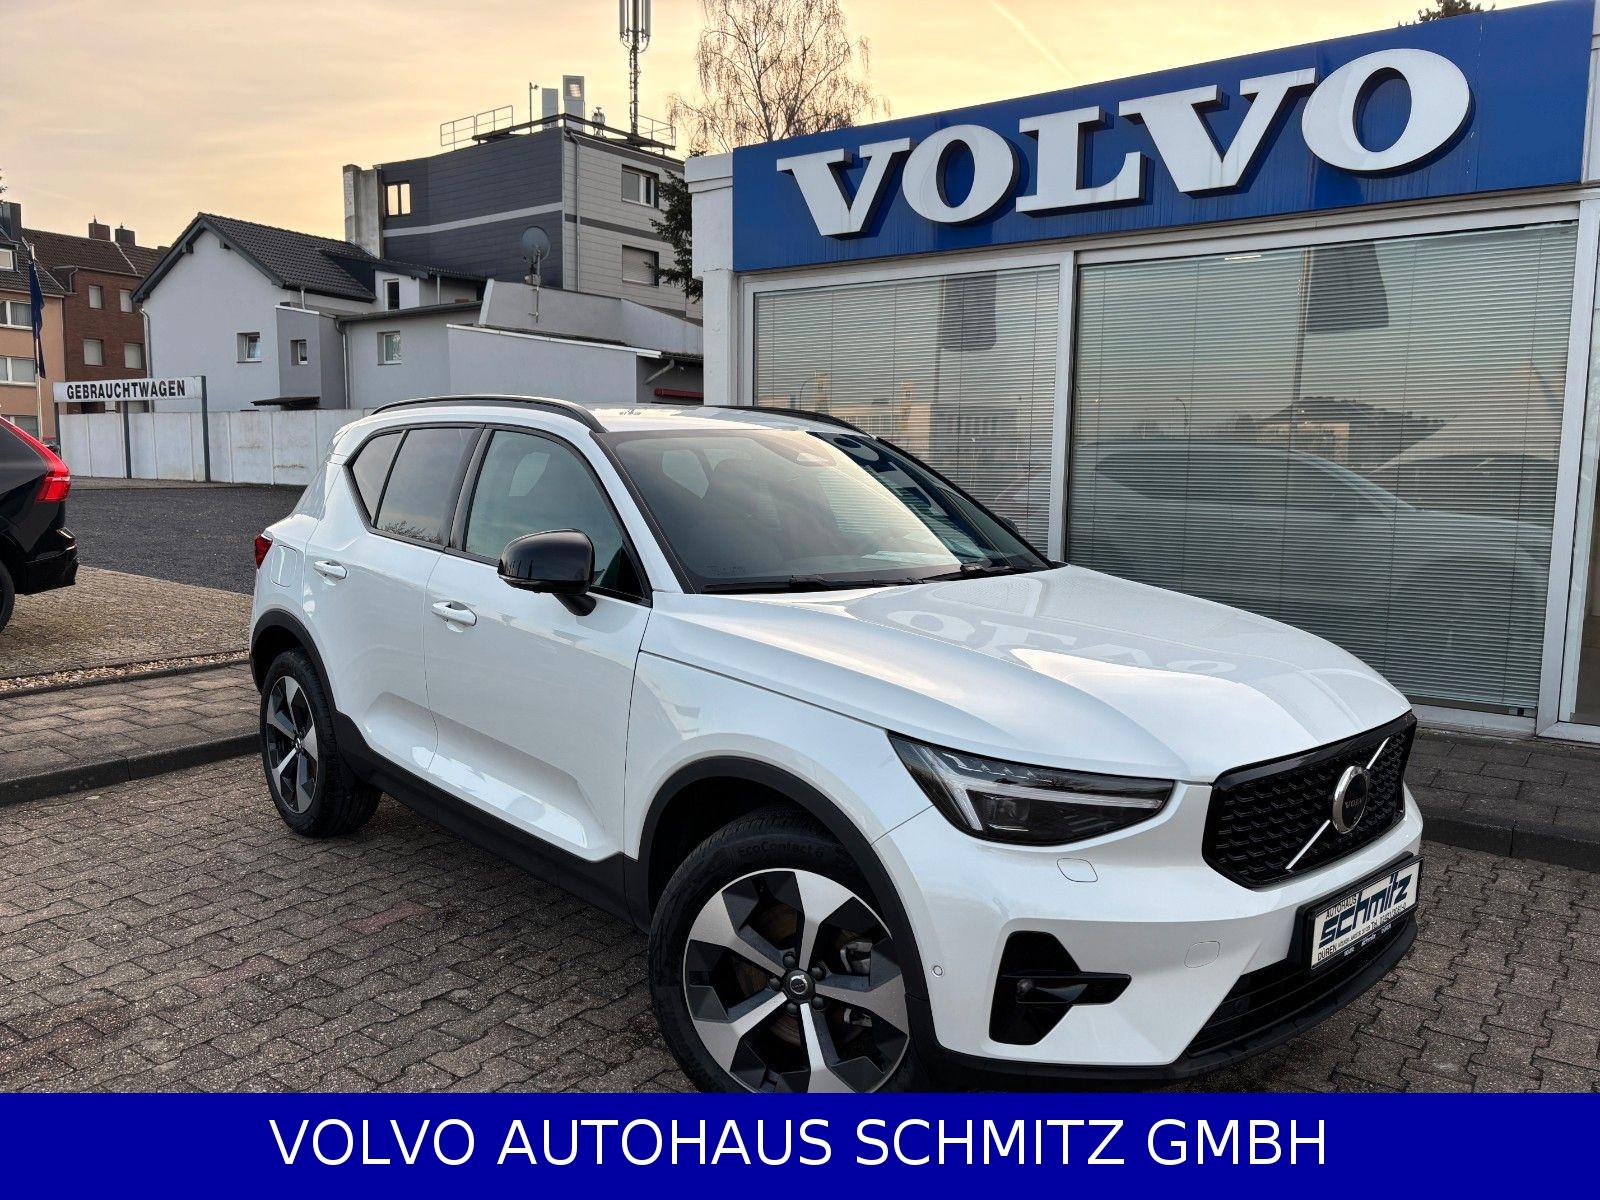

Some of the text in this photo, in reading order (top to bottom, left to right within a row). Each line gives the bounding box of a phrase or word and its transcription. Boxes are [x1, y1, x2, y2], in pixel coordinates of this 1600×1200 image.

[775, 47, 1472, 237] VOLVO
[66, 379, 187, 400] GEBRAUCHTWAGEN
[1325, 894, 1358, 919] AUTOHAUS
